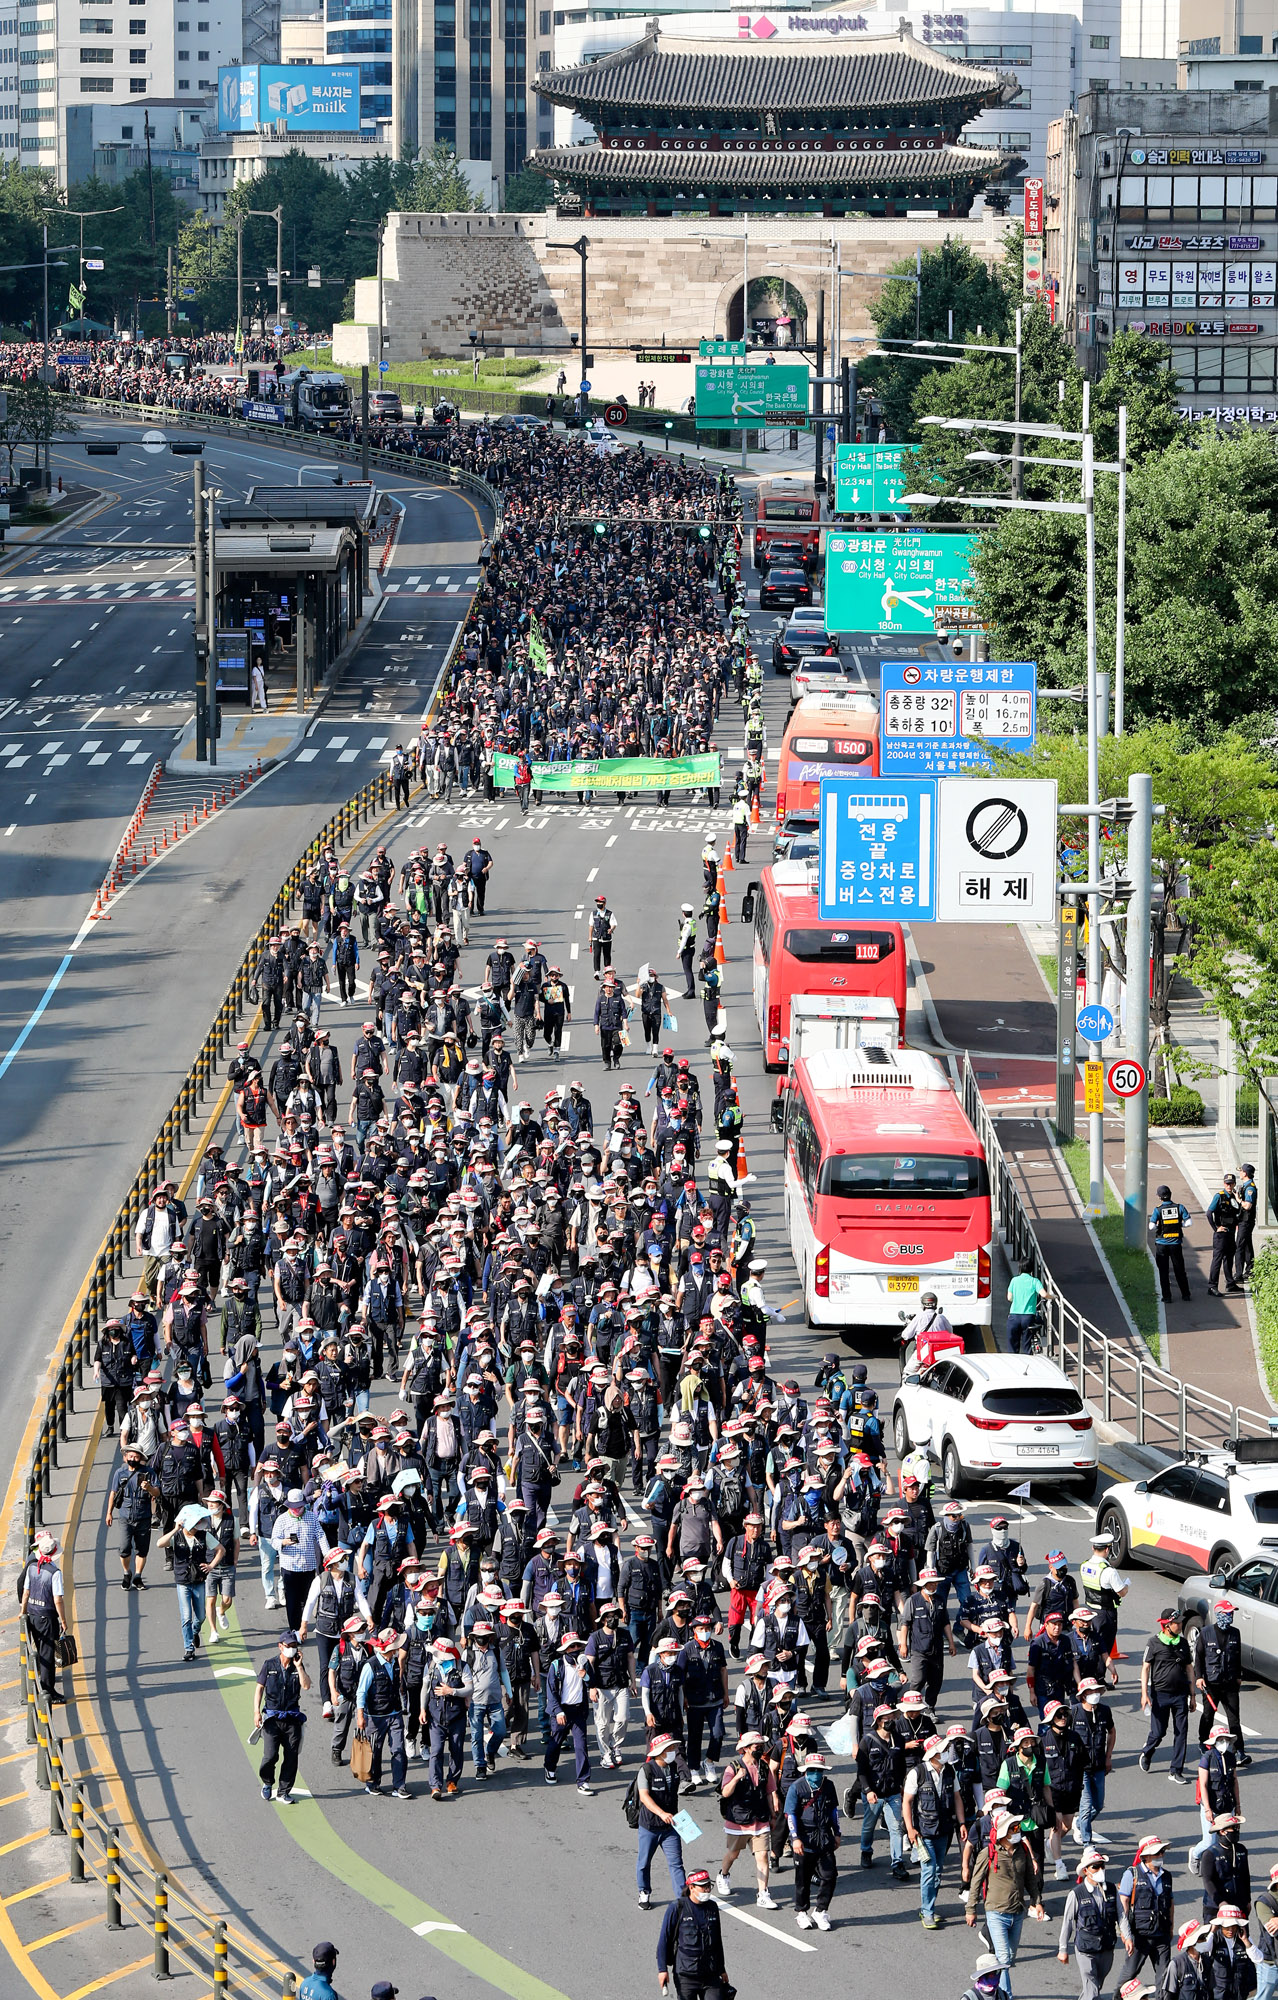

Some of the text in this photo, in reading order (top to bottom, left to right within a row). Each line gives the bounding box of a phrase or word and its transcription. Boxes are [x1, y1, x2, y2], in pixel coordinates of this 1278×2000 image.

[788, 14, 868, 34] Heungkuk
[312, 86, 352, 98] 복사지는
[312, 100, 347, 113] miilk
[1148, 150, 1224, 164] 승리 인력 안내소
[1028, 190, 1039, 232] 무도학원
[1130, 236, 1225, 249] 사교 댄스 스포츠
[1125, 270, 1273, 283] 영 무도 학원 자이브 룸바 왈츠
[1200, 321, 1225, 335] 포토
[706, 344, 739, 354] 숭례문
[709, 369, 734, 378] 광화문
[765, 393, 798, 402] 한국은행
[610, 410, 623, 420] 50
[833, 541, 844, 550] 50
[848, 539, 887, 553] 광화문
[893, 538, 920, 547] 光化門
[892, 548, 942, 558] Gwanghwamun
[845, 562, 855, 571] 60
[894, 572, 907, 580] City
[878, 622, 902, 630] 180m
[924, 669, 1014, 683] 차량운행제한
[890, 695, 925, 710] 총중량
[965, 693, 1028, 705] 높이 4.0m
[965, 708, 1028, 720] 길이 16.7m
[890, 717, 924, 732] 축하중
[972, 722, 1028, 733] 폭 2.5m
[837, 742, 865, 754] 1500
[859, 822, 897, 841] 전용
[869, 843, 888, 860] 끝
[840, 860, 916, 881] 중앙차로
[966, 877, 1028, 900] 해제
[840, 886, 916, 905] 버스전용
[1065, 929, 1072, 940] 4
[857, 946, 879, 959] 1102
[1064, 956, 1072, 986] 서울역
[1116, 1070, 1137, 1088] 50
[896, 1282, 917, 1290] 3970
